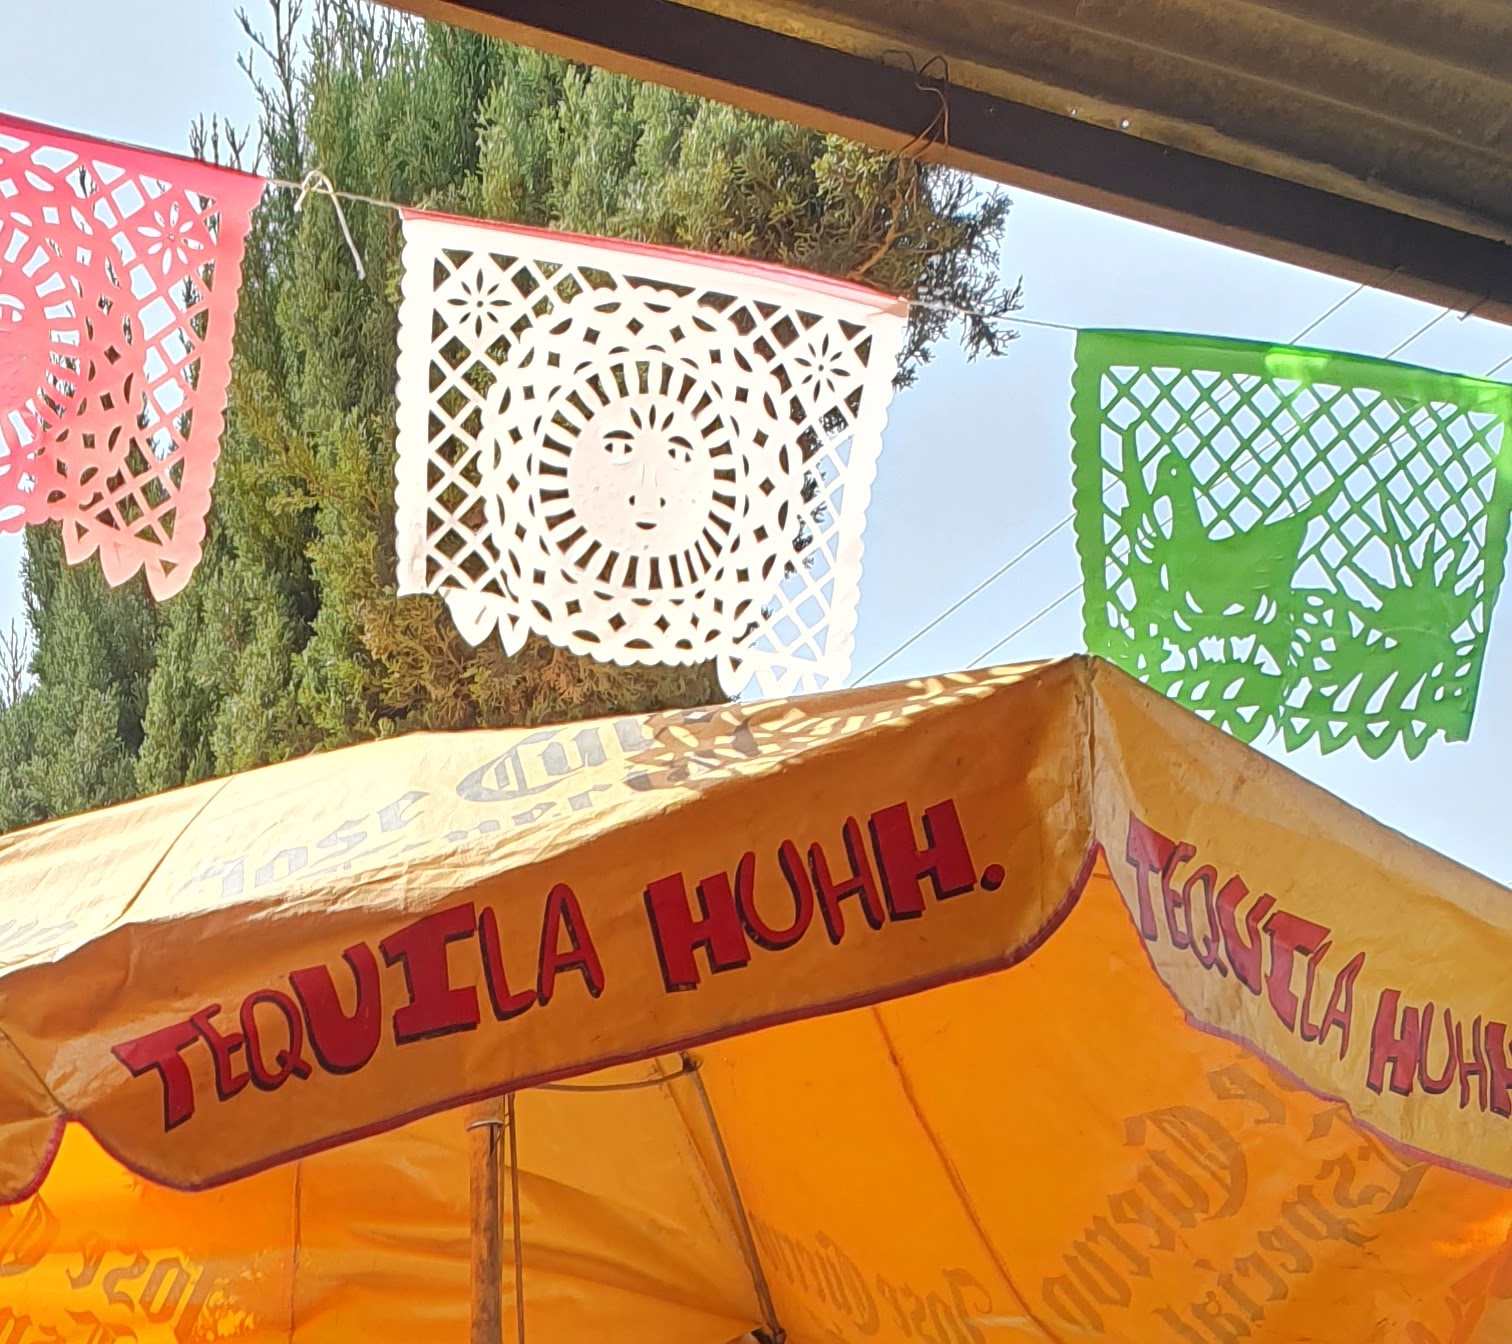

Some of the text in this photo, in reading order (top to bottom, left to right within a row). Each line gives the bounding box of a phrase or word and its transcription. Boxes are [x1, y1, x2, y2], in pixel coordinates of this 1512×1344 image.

[112, 800, 1006, 1132] TEQUILA HUHH.
[1125, 810, 1365, 1061] TEQUILA
